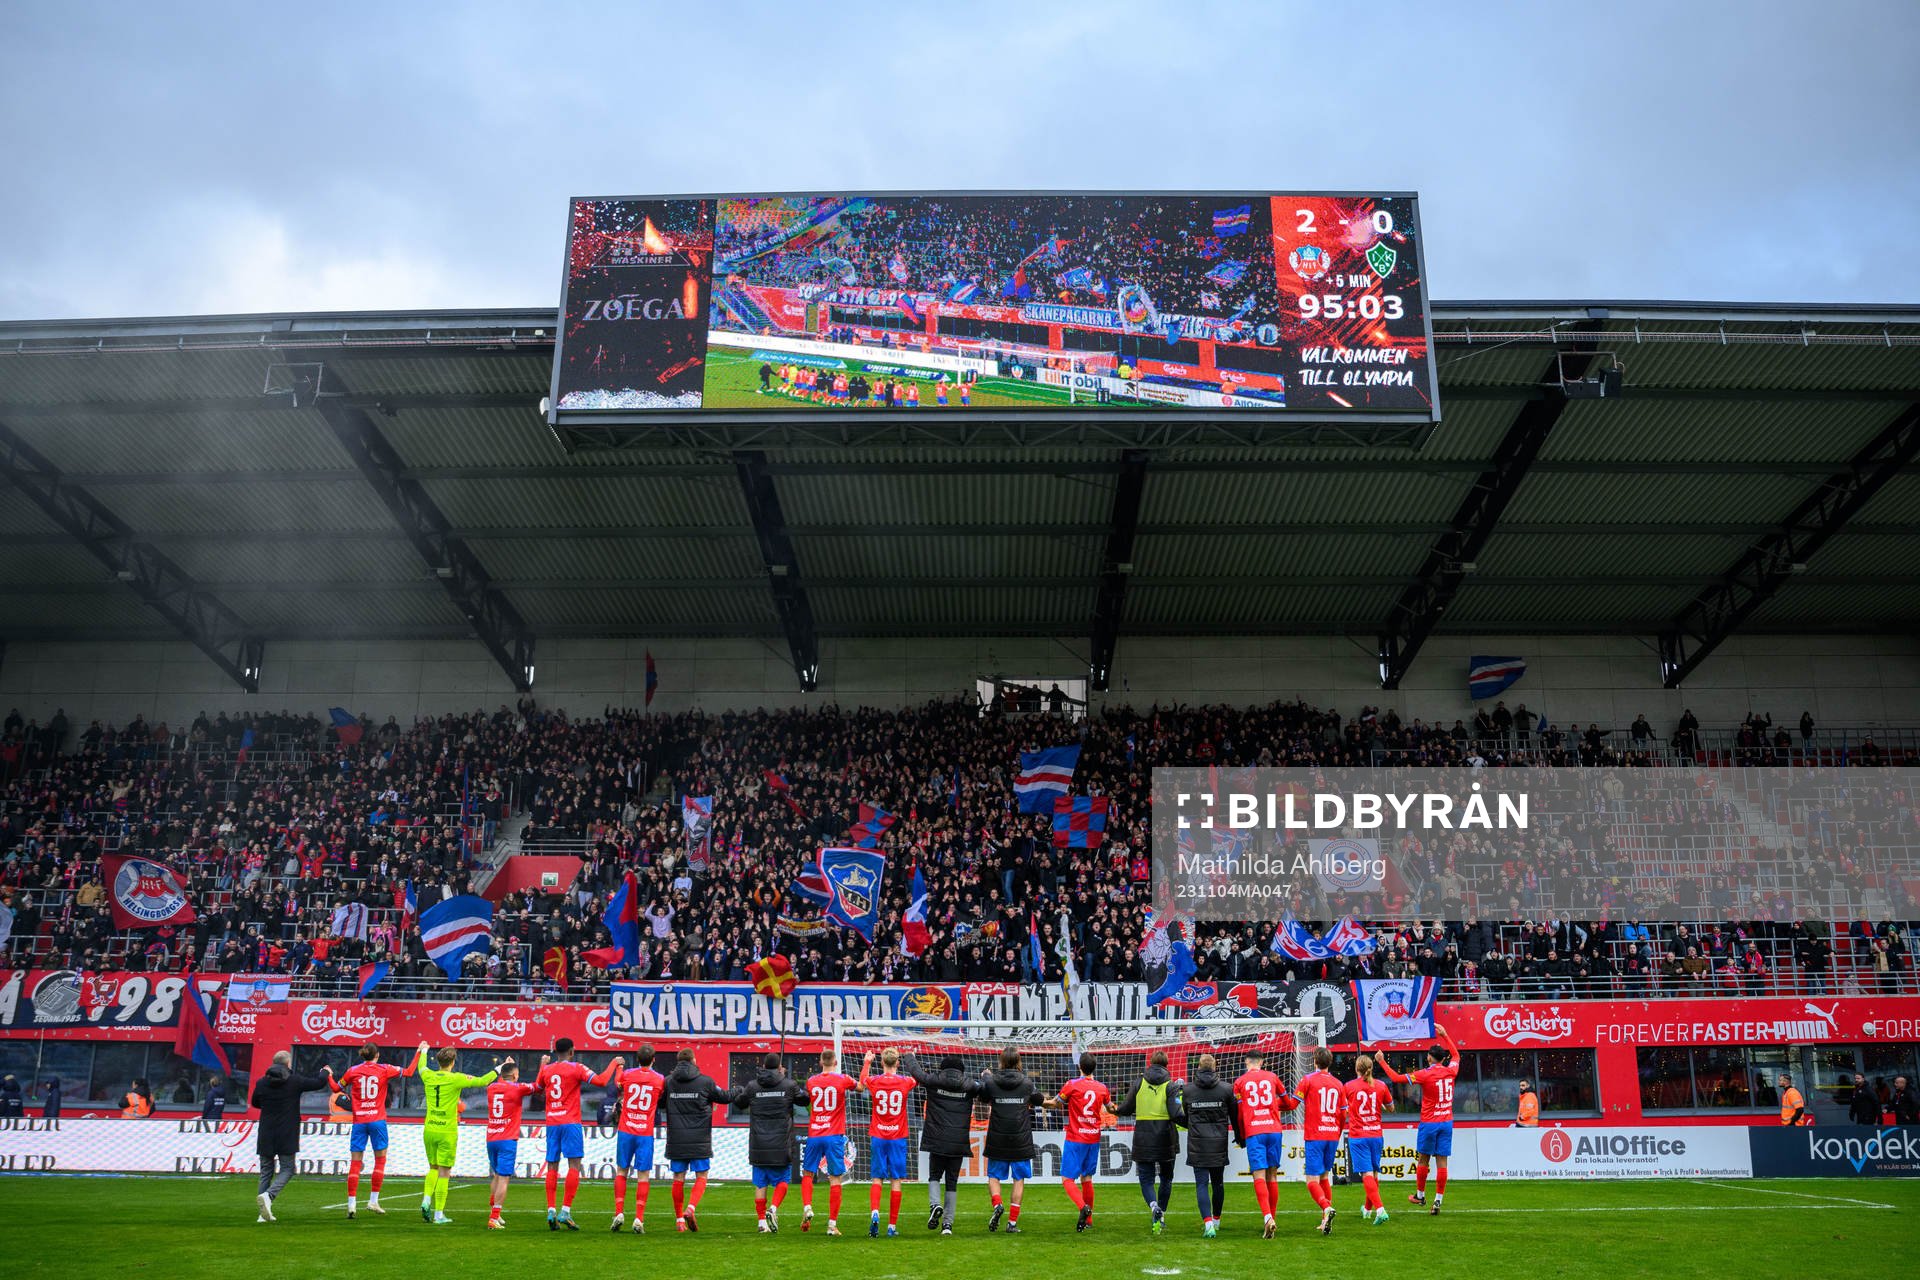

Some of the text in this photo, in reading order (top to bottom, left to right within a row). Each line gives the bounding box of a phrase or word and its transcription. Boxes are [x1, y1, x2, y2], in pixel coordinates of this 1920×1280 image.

[1296, 209, 1317, 232] 2
[1373, 210, 1394, 234] 0
[611, 256, 673, 264] MASKINER
[1349, 275, 1371, 288] MIN
[1298, 294, 1404, 319] 95:03
[866, 364, 901, 373] UNIBET
[1298, 369, 1414, 387] TILL OLYMPIA
[122, 898, 181, 918] HELSINGBORGS
[968, 983, 1019, 994] ACAB
[1308, 982, 1347, 997] POTENTIALS
[219, 1010, 257, 1024] beat
[302, 1004, 386, 1036] Carlsberg
[1390, 1005, 1402, 1014] HIF
[218, 1024, 255, 1034] diabetes
[441, 1007, 526, 1038] Carlsberg
[1484, 1007, 1572, 1037] Carlsberg
[1596, 1023, 1689, 1043] FOREVER
[359, 1075, 379, 1099] 16
[434, 1085, 441, 1108] 1
[550, 1074, 562, 1099] 3
[626, 1083, 653, 1111] 25
[1245, 1080, 1273, 1107] 33
[1435, 1079, 1454, 1102] 15
[493, 1094, 505, 1117] 5
[811, 1086, 837, 1112] 20
[875, 1090, 903, 1116] 39
[1083, 1090, 1096, 1116] 2
[1318, 1087, 1338, 1114] 10
[1356, 1091, 1377, 1115] 21
[1575, 1136, 1686, 1155] AllOffice
[1564, 1169, 1589, 1178] Servering
[1595, 1169, 1620, 1177] Inredning
[1627, 1168, 1652, 1176] Konferens
[1659, 1168, 1673, 1177] Tryck
[1701, 1168, 1750, 1176] Dokumenthantering
